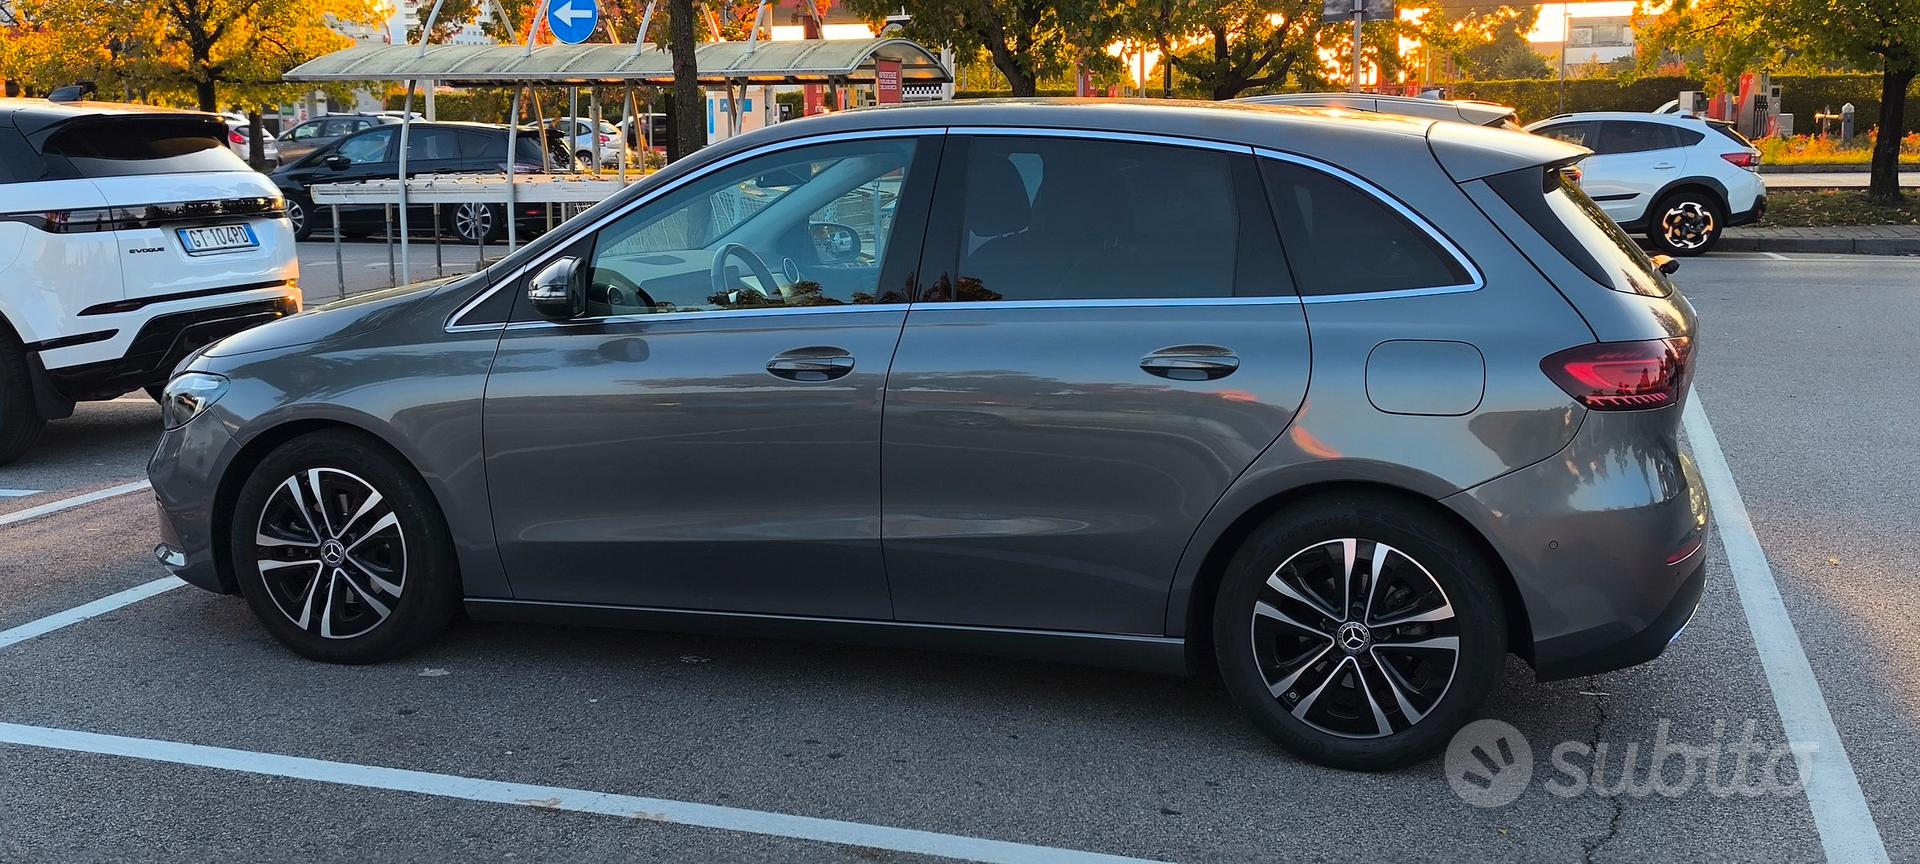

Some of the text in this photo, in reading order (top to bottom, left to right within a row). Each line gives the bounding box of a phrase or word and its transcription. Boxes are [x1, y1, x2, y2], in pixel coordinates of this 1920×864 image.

[189, 226, 249, 248] GT 104PD
[128, 246, 165, 254] EVOQUE
